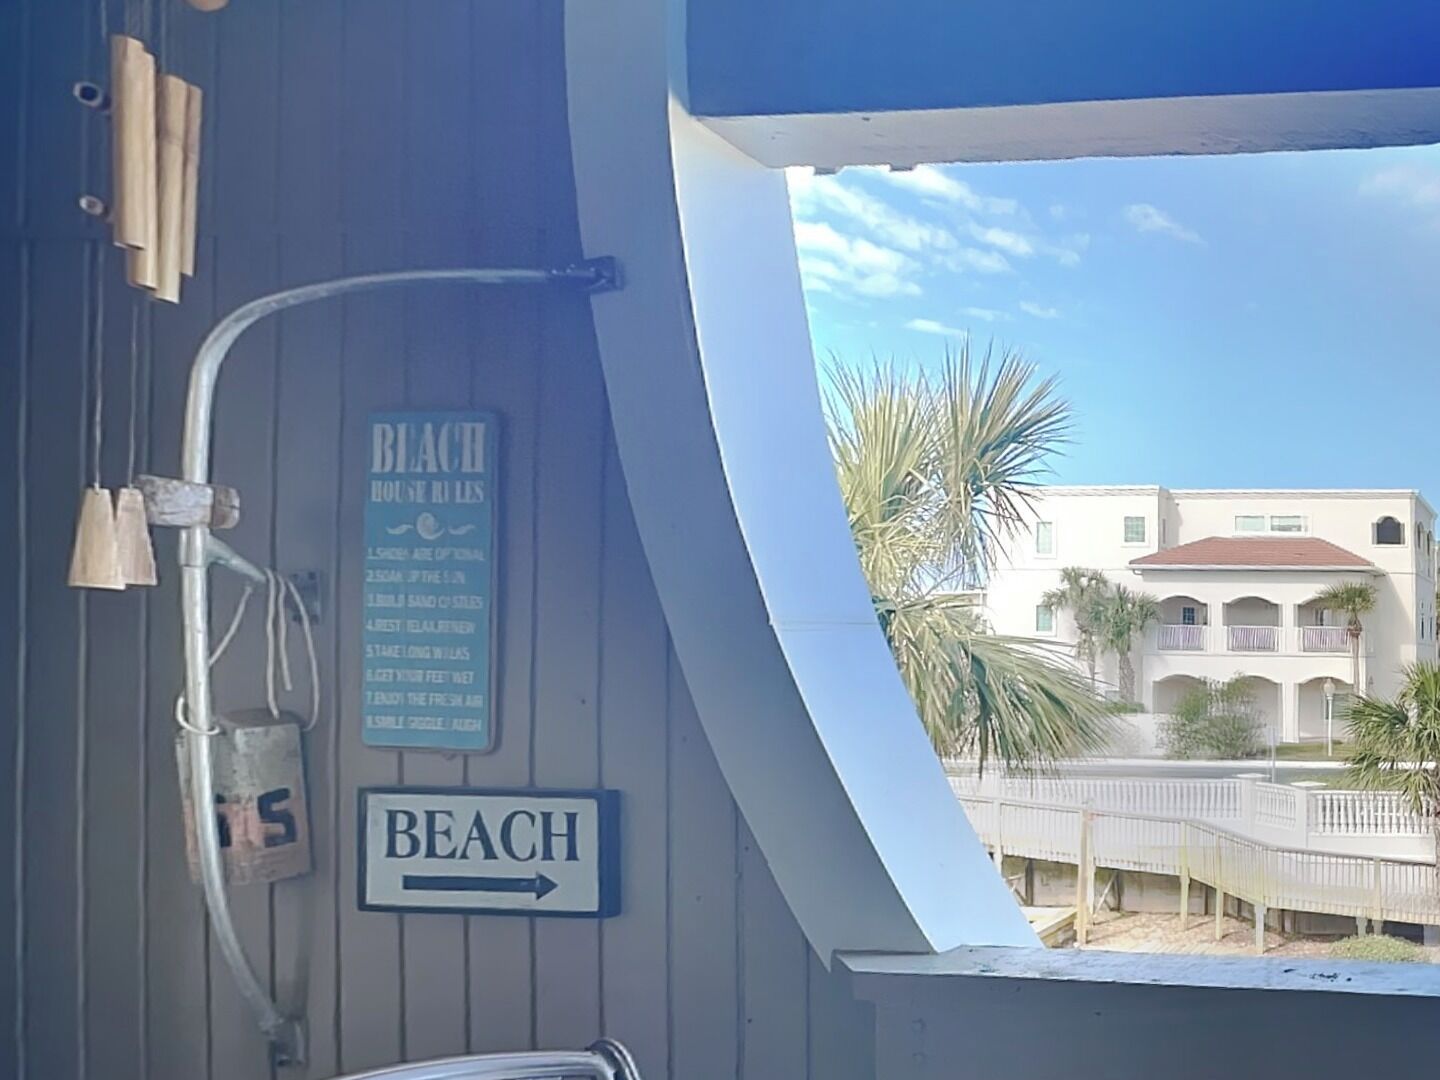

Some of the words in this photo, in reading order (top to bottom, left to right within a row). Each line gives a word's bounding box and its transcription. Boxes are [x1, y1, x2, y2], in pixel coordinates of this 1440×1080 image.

[371, 422, 485, 473] BEACH
[371, 480, 426, 503] HOUSE
[431, 480, 484, 504] RULES
[385, 809, 580, 862] BEACH
